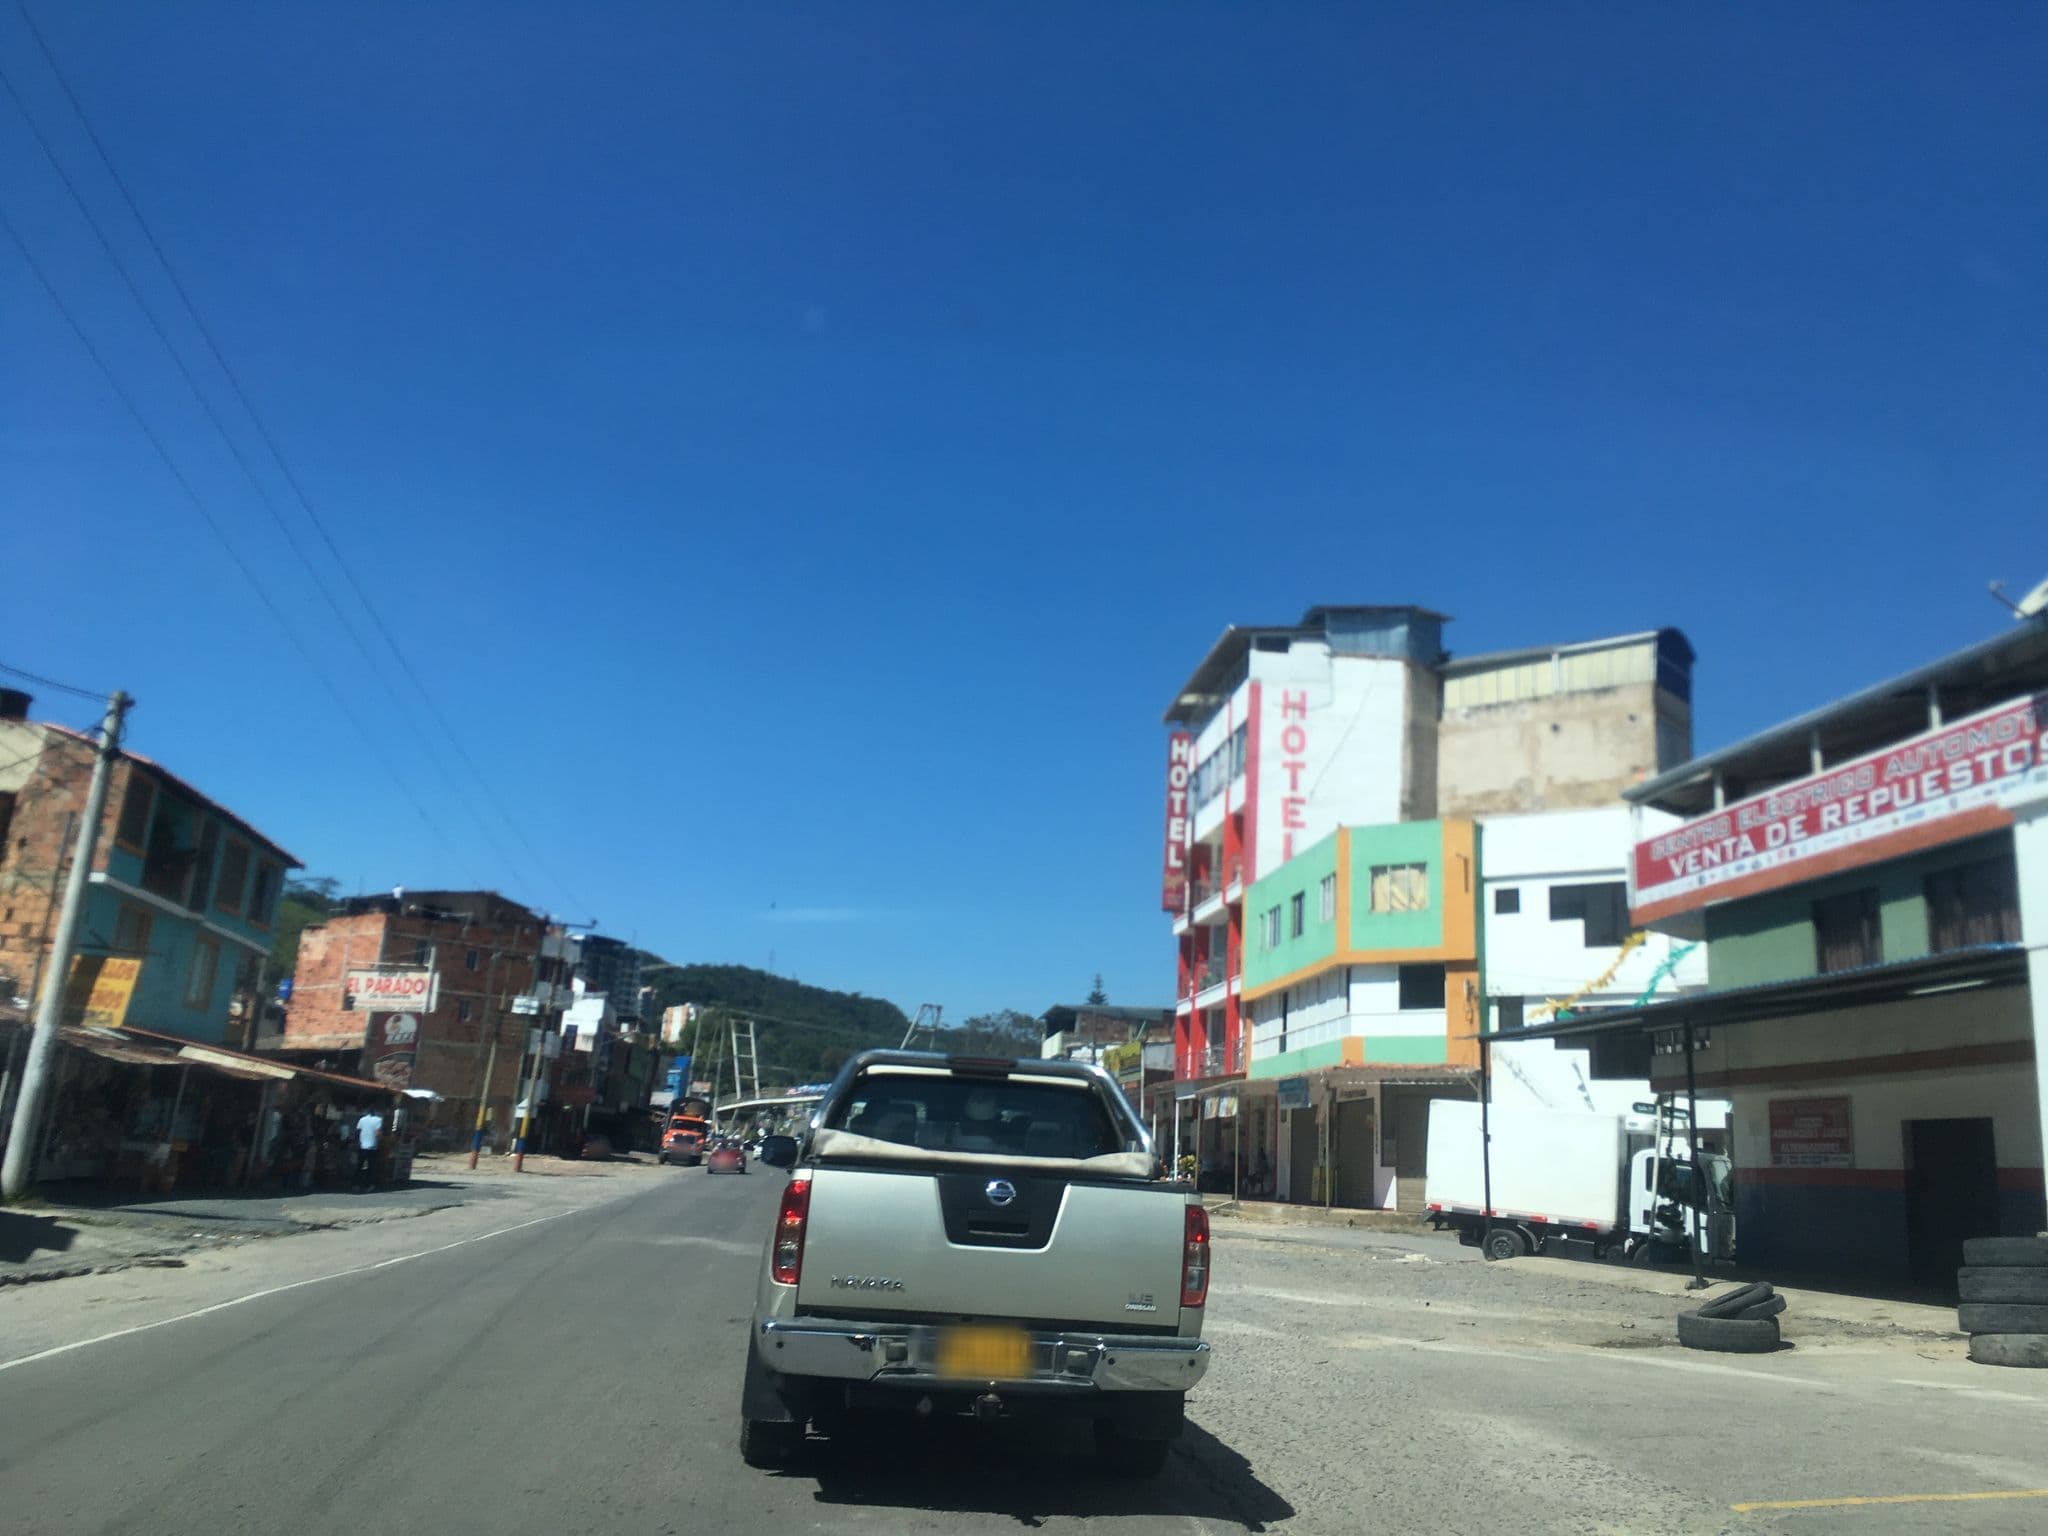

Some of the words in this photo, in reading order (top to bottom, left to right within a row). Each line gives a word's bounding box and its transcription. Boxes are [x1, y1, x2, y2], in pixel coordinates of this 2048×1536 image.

[1168, 738, 1189, 868] HOTEL
[1668, 833, 1757, 877] VENTA
[1766, 815, 1808, 848] DE
